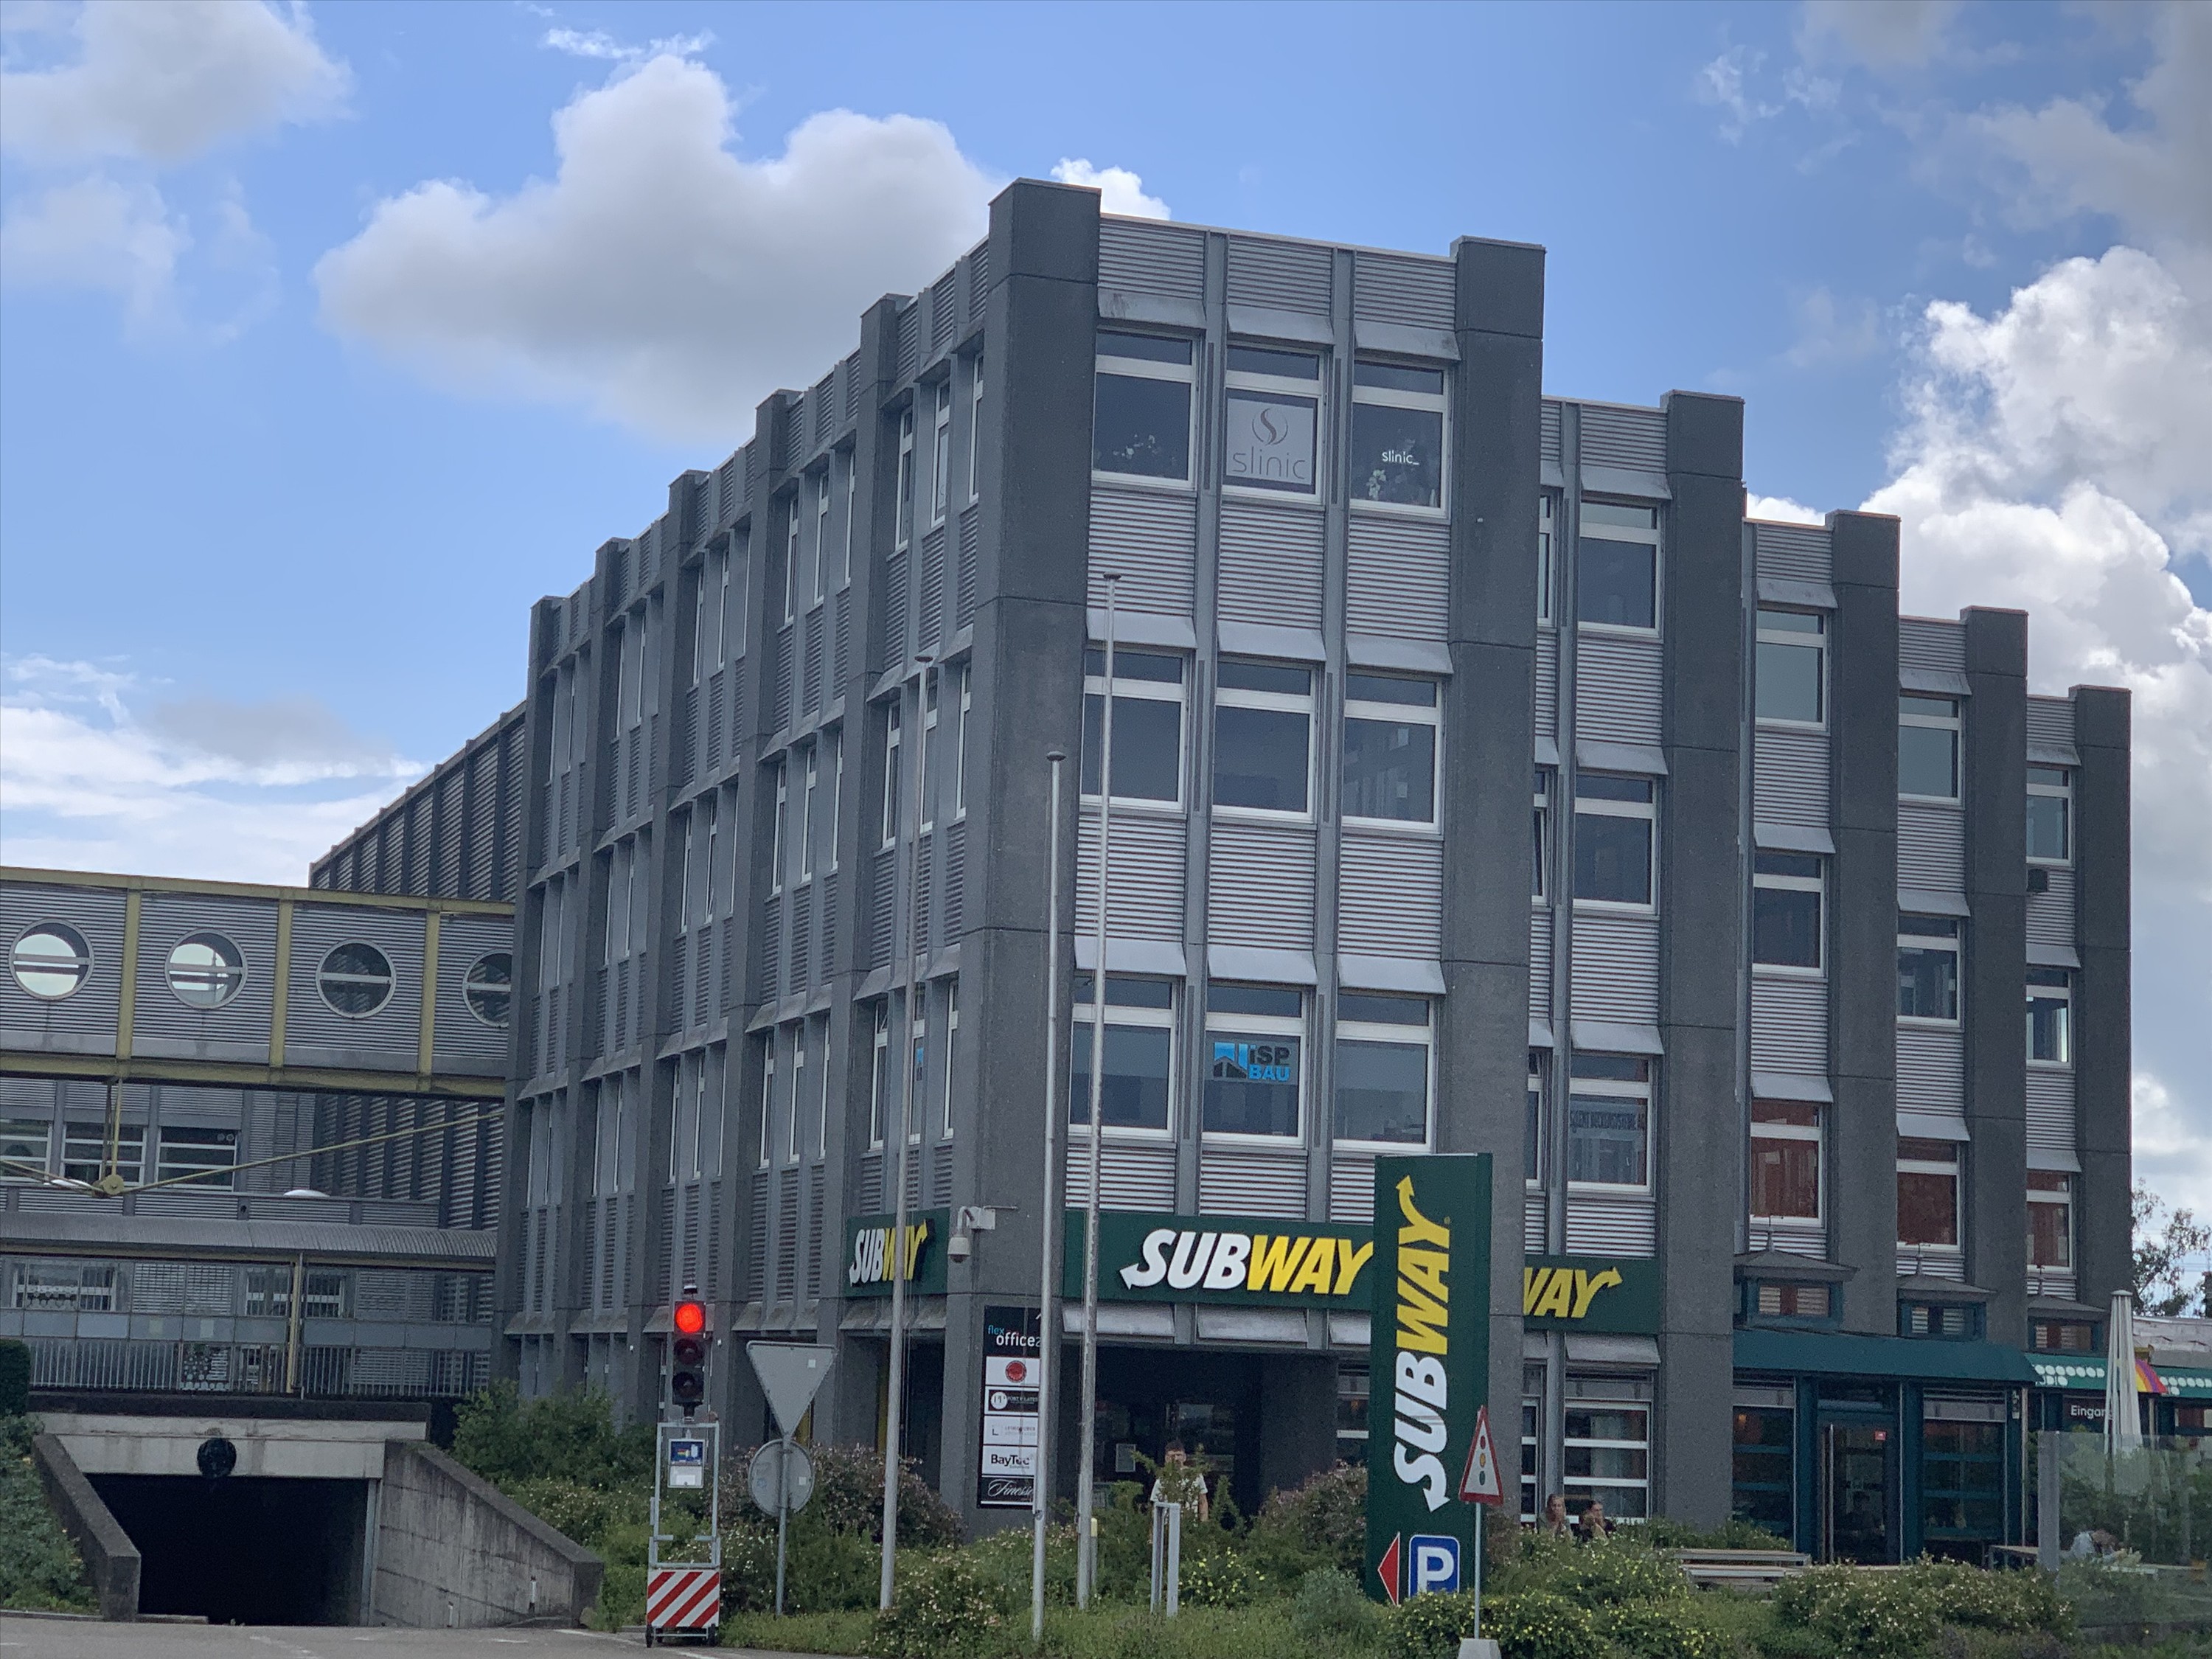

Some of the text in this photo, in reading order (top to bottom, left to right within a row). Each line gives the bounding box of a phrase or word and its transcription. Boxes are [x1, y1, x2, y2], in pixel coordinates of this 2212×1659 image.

[1232, 445, 1306, 480] slinic
[1248, 1065, 1290, 1082] BAU
[1119, 1228, 1374, 1295] SUBWAY
[1394, 1174, 1451, 1514] SUBWAY
[1416, 1545, 1455, 1594] P
